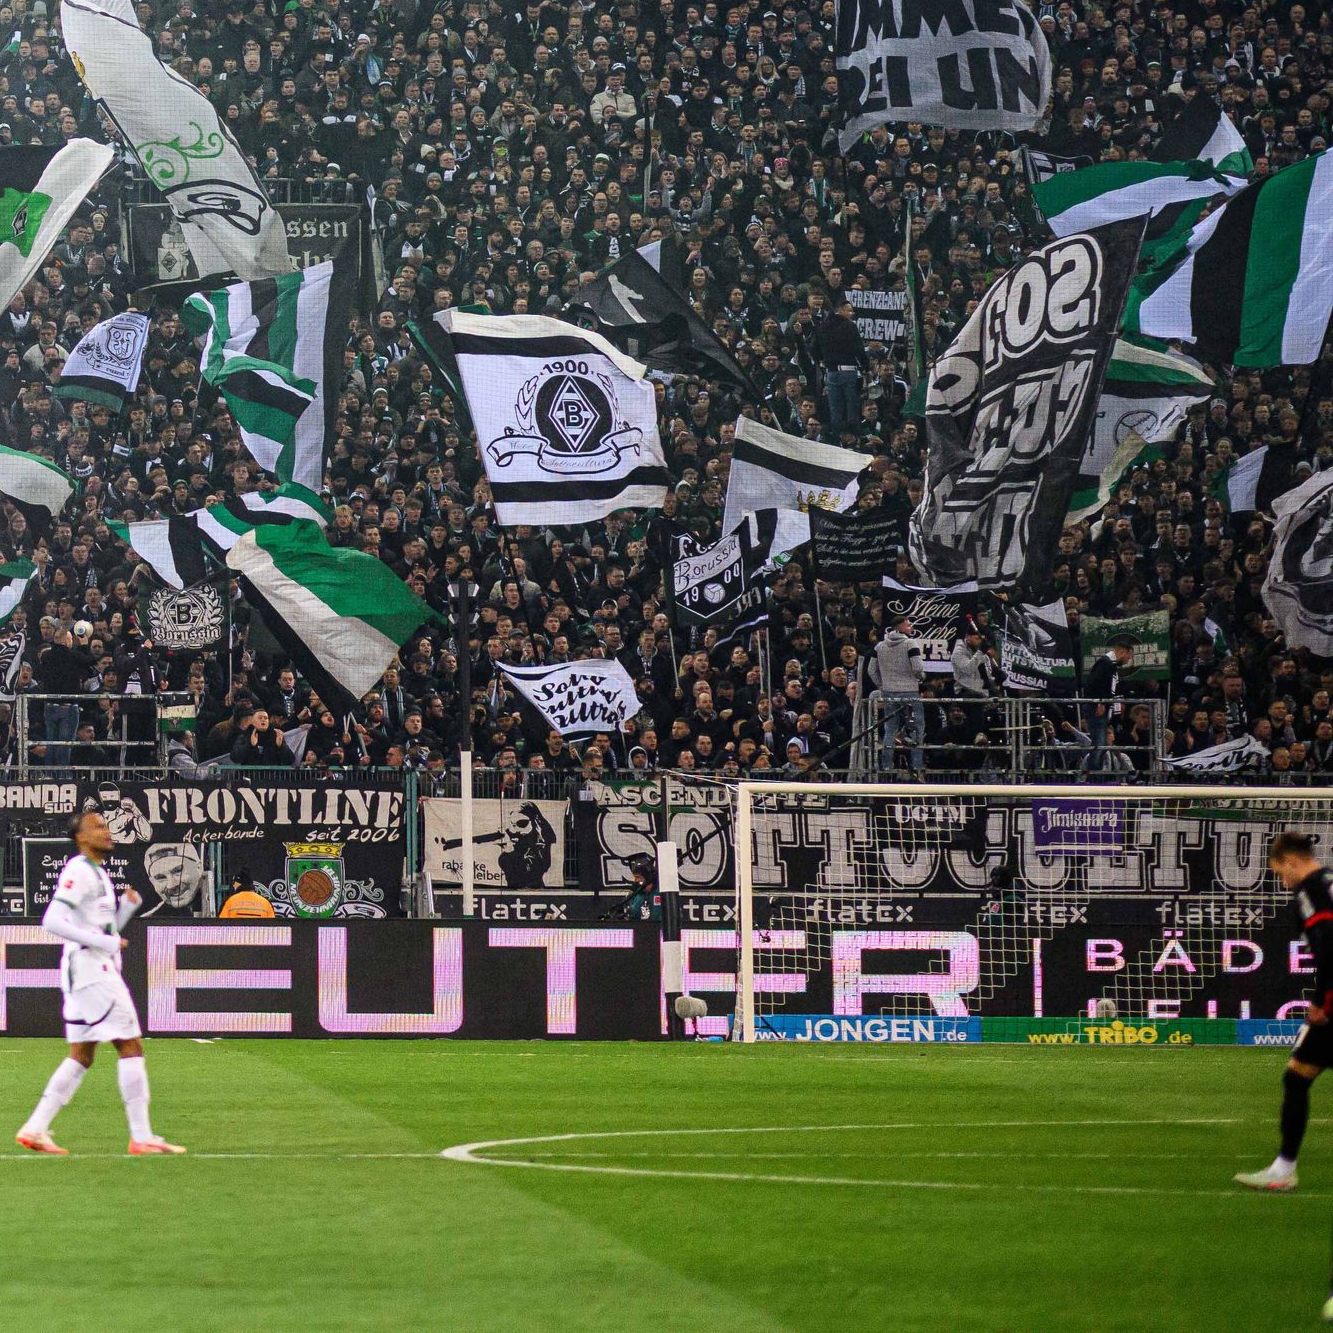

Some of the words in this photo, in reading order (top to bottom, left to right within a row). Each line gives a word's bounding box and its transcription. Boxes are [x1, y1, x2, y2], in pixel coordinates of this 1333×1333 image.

[543, 359, 589, 375] 1900
[887, 593, 961, 619] Meine
[152, 626, 222, 642] Borussia
[144, 787, 406, 829] FRONTLINE
[182, 827, 265, 844] Ackerbande
[305, 826, 340, 844] seit
[345, 827, 401, 844] 2006
[442, 860, 486, 874] rabake
[1087, 930, 1317, 974] BÄDE
[796, 1019, 935, 1042] JONGEN
